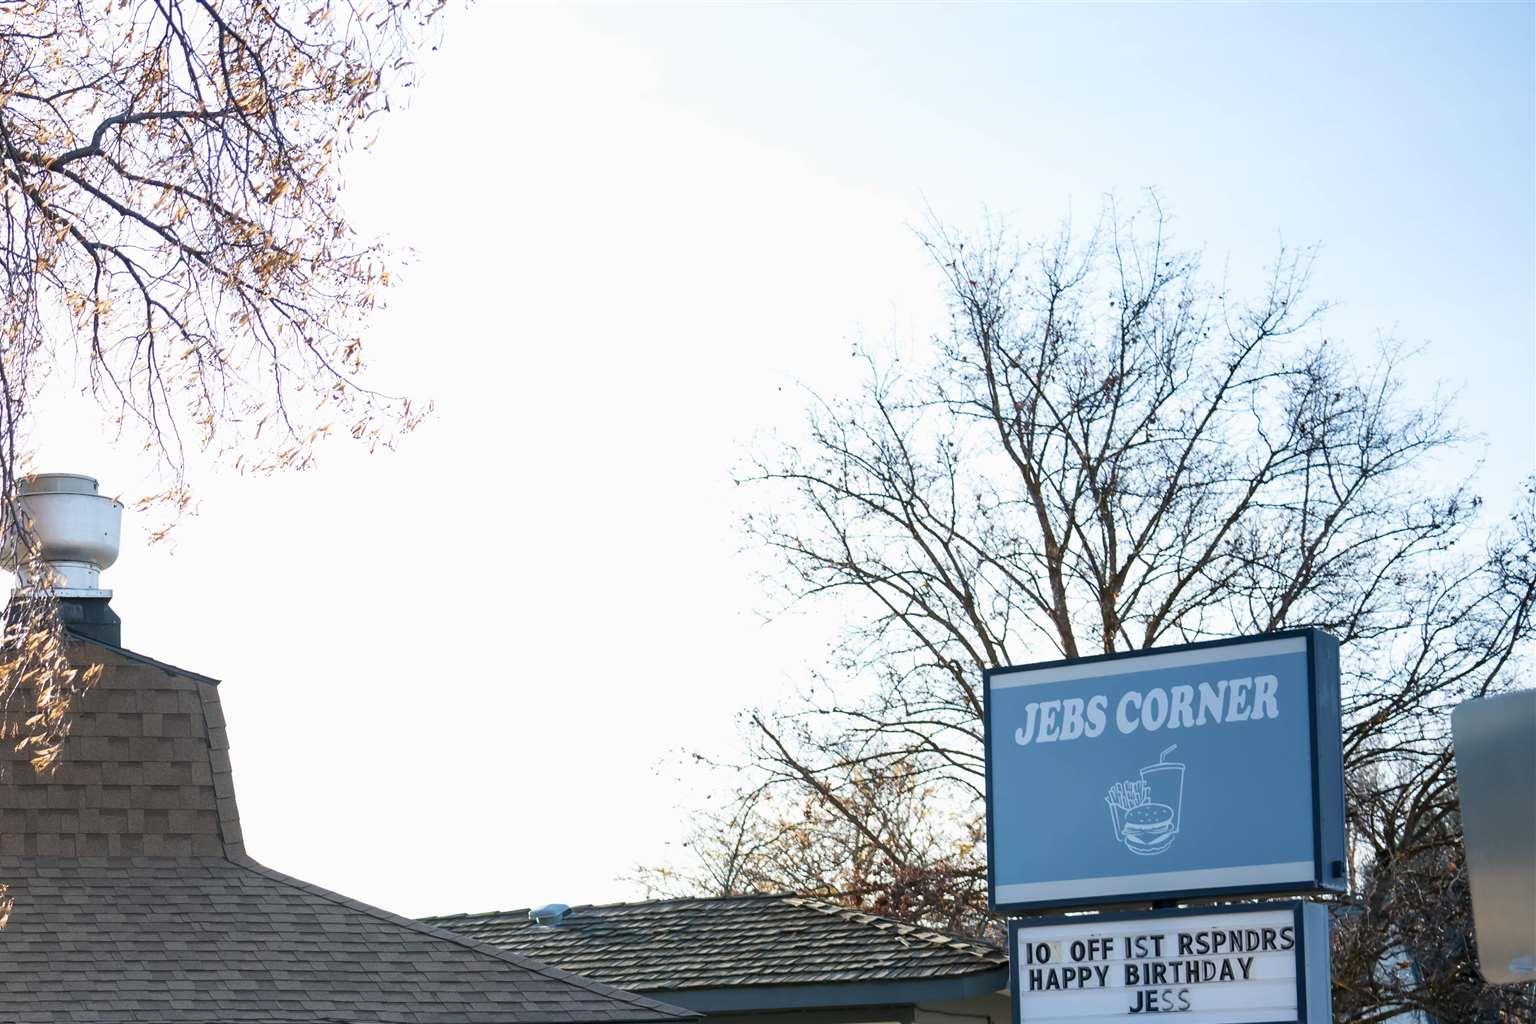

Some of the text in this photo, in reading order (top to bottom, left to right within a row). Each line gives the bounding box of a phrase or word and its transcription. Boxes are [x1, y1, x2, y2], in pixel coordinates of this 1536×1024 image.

[1014, 674, 1280, 746] JEBS CORNER
[1070, 937, 1114, 962] OFF
[1178, 926, 1295, 955] RSPNDRS
[1029, 957, 1254, 991] HAPPY BIRTHDAY
[1129, 988, 1192, 1013] JESS
